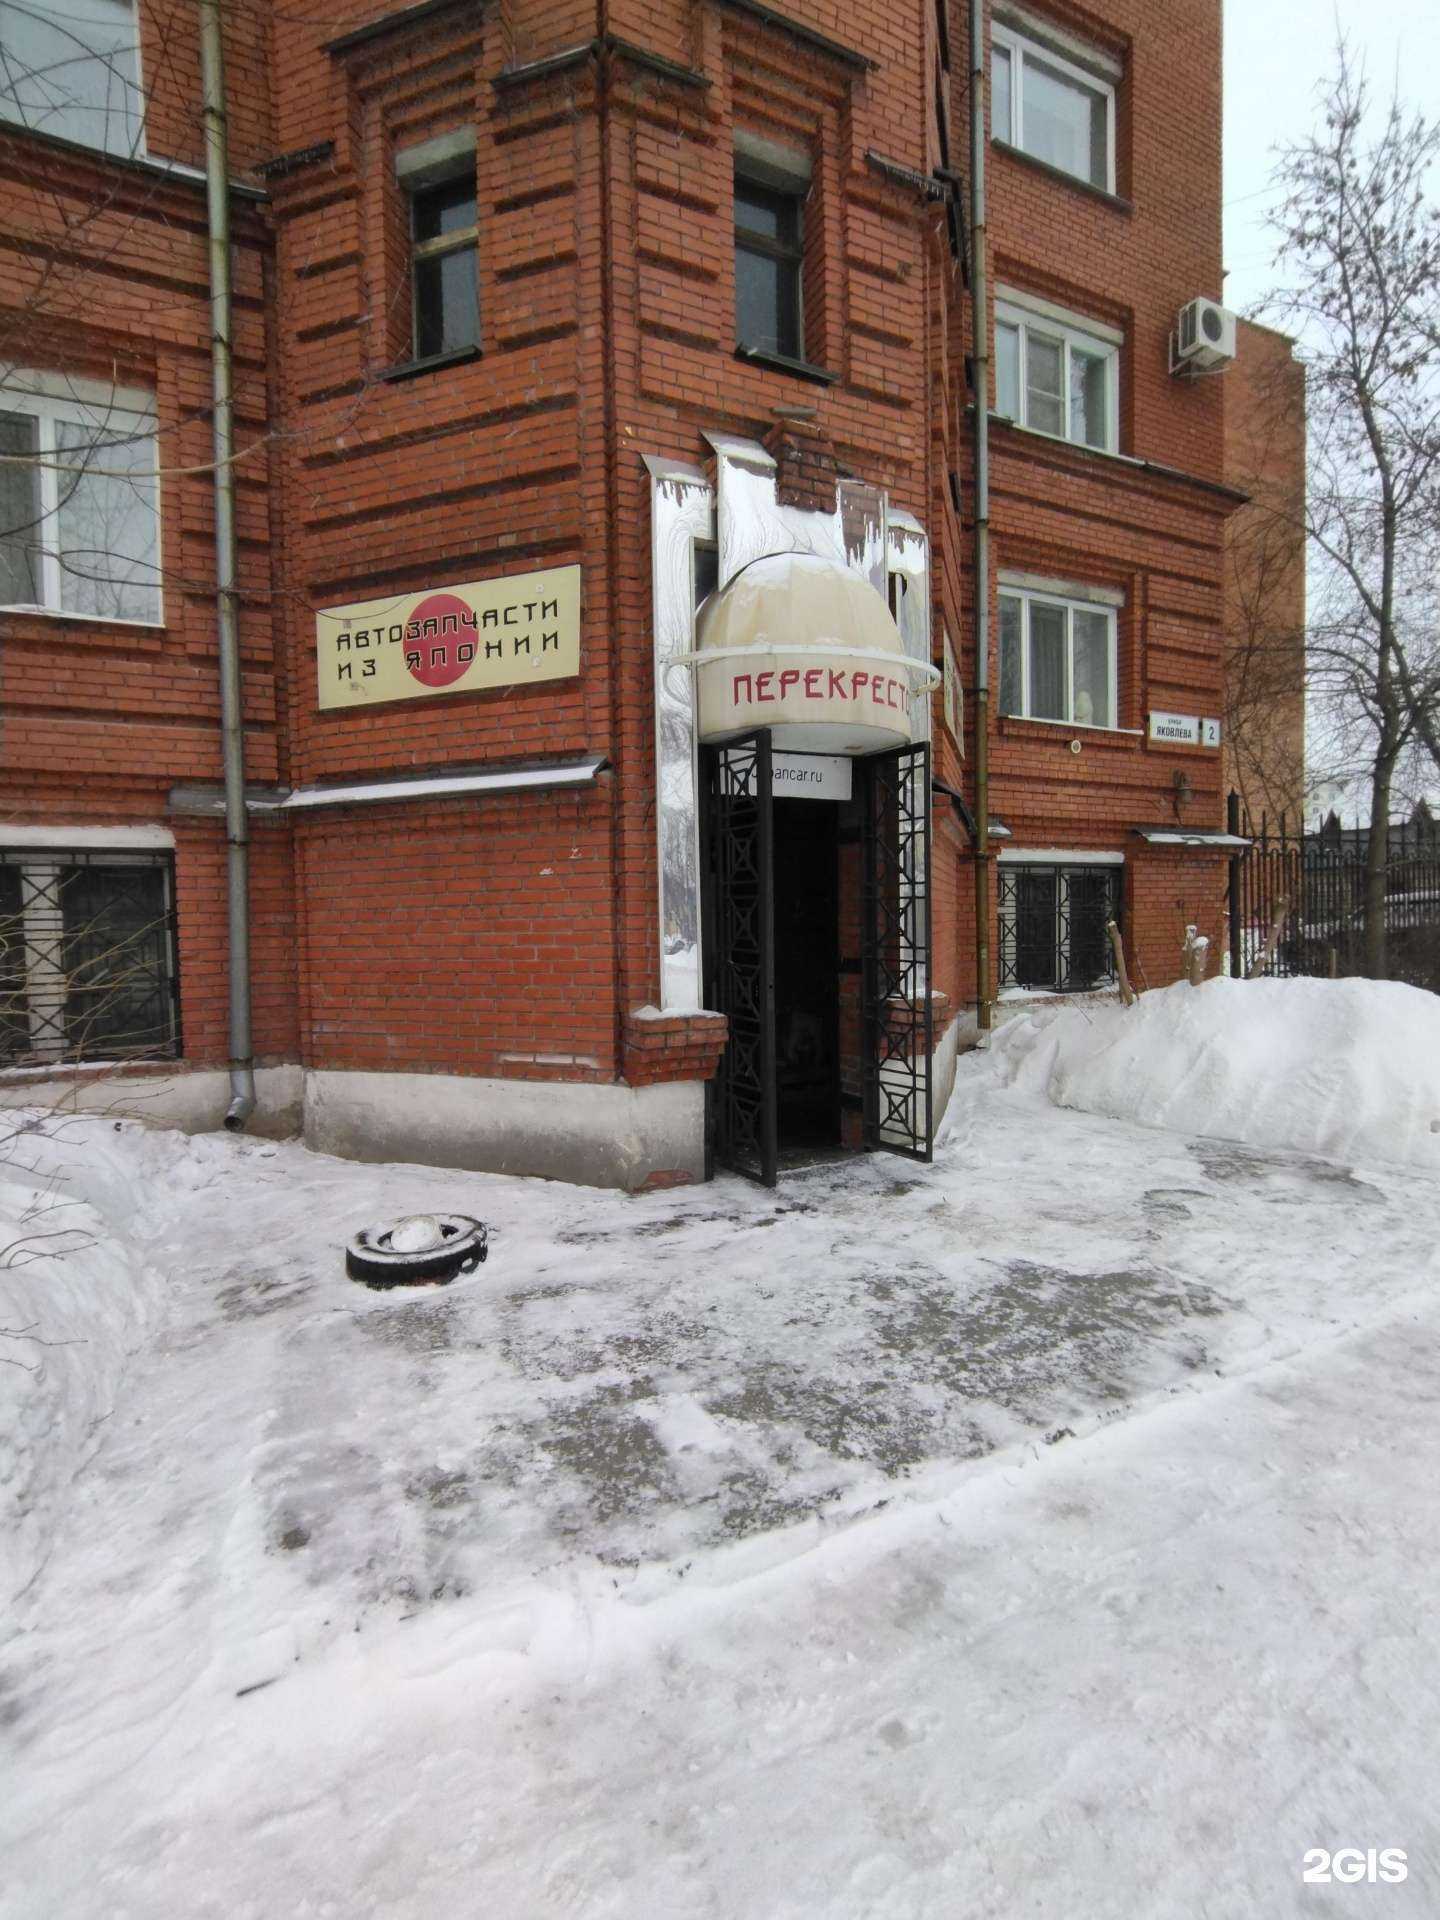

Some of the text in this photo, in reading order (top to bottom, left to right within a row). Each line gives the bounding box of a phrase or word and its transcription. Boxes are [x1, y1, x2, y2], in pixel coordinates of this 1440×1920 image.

[336, 599, 559, 652] АВТОЗАПЧАСТИ
[338, 631, 559, 680] ИЗ ЯПОНИИ
[1156, 726, 1193, 739] ЯКОВЛЕВА
[1208, 726, 1216, 740] 2
[752, 767, 823, 784] ancar.ru
